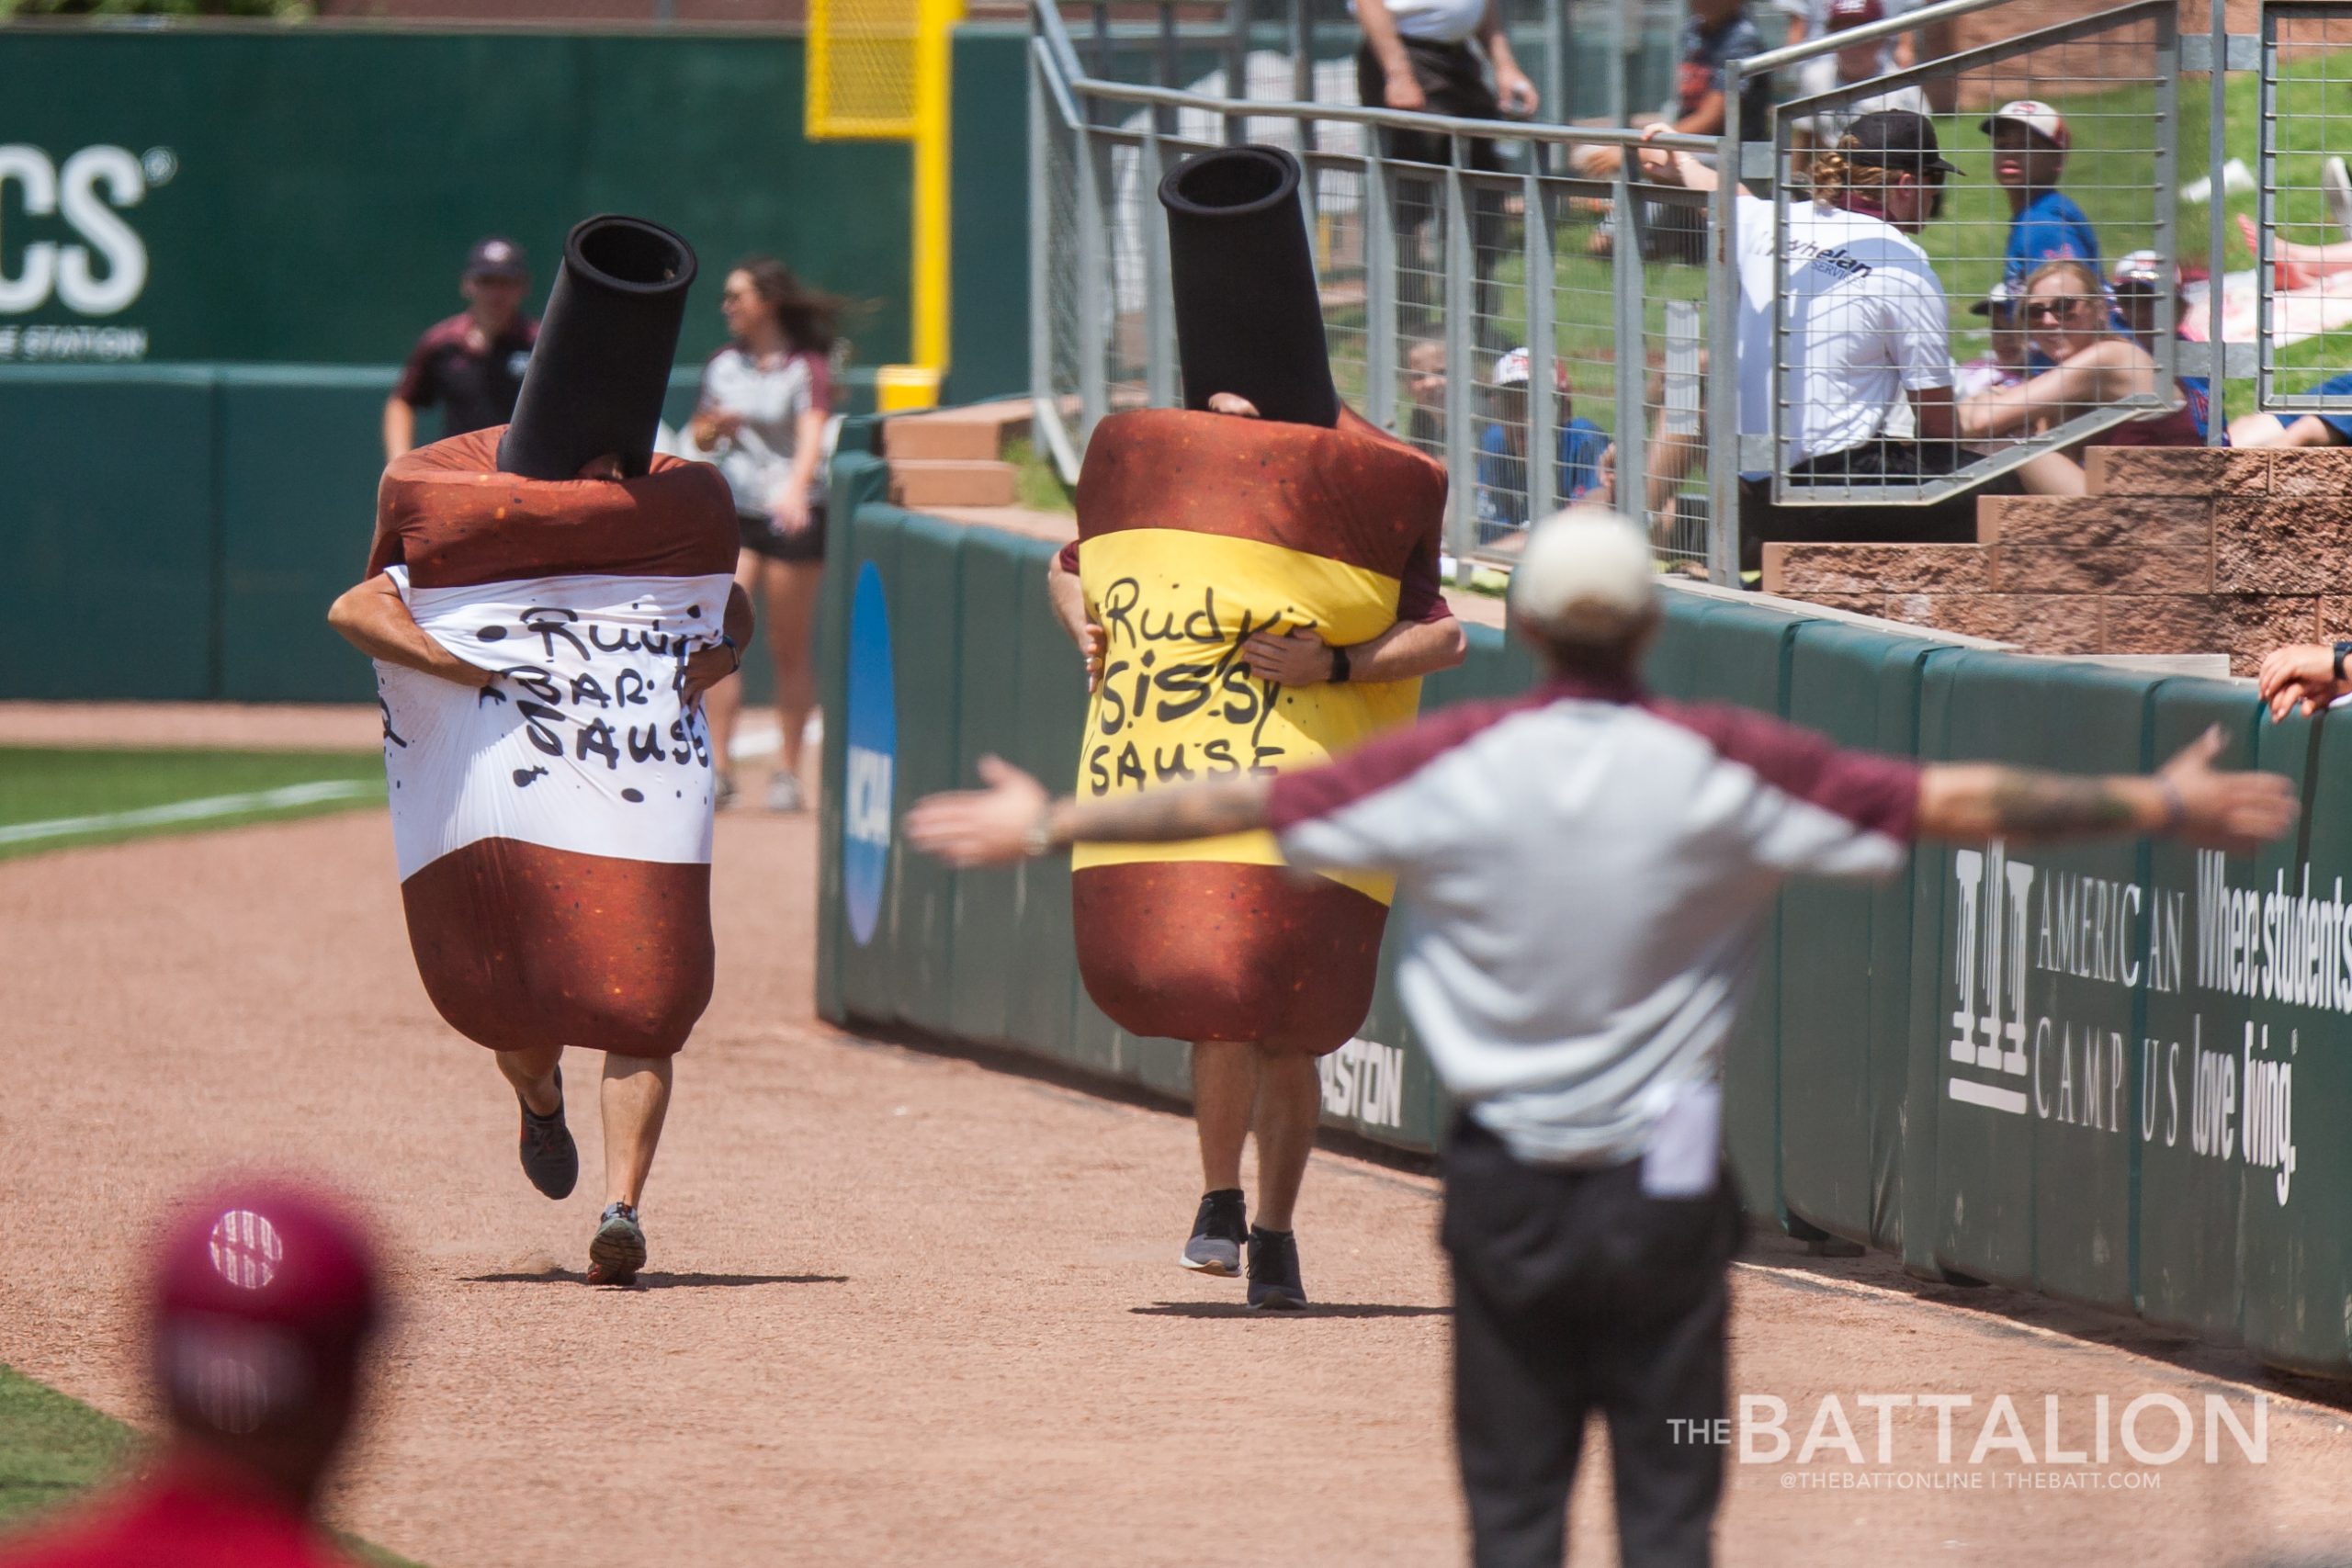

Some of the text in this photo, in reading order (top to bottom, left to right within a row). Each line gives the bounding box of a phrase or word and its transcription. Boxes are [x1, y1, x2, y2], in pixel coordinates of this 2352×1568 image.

[2036, 868, 2185, 995] AMERICAN
[2197, 847, 2352, 1014] Where students
[1315, 1036, 1404, 1128] ASTON
[2034, 1017, 2180, 1148] CAMPUS
[2192, 1013, 2235, 1161] love
